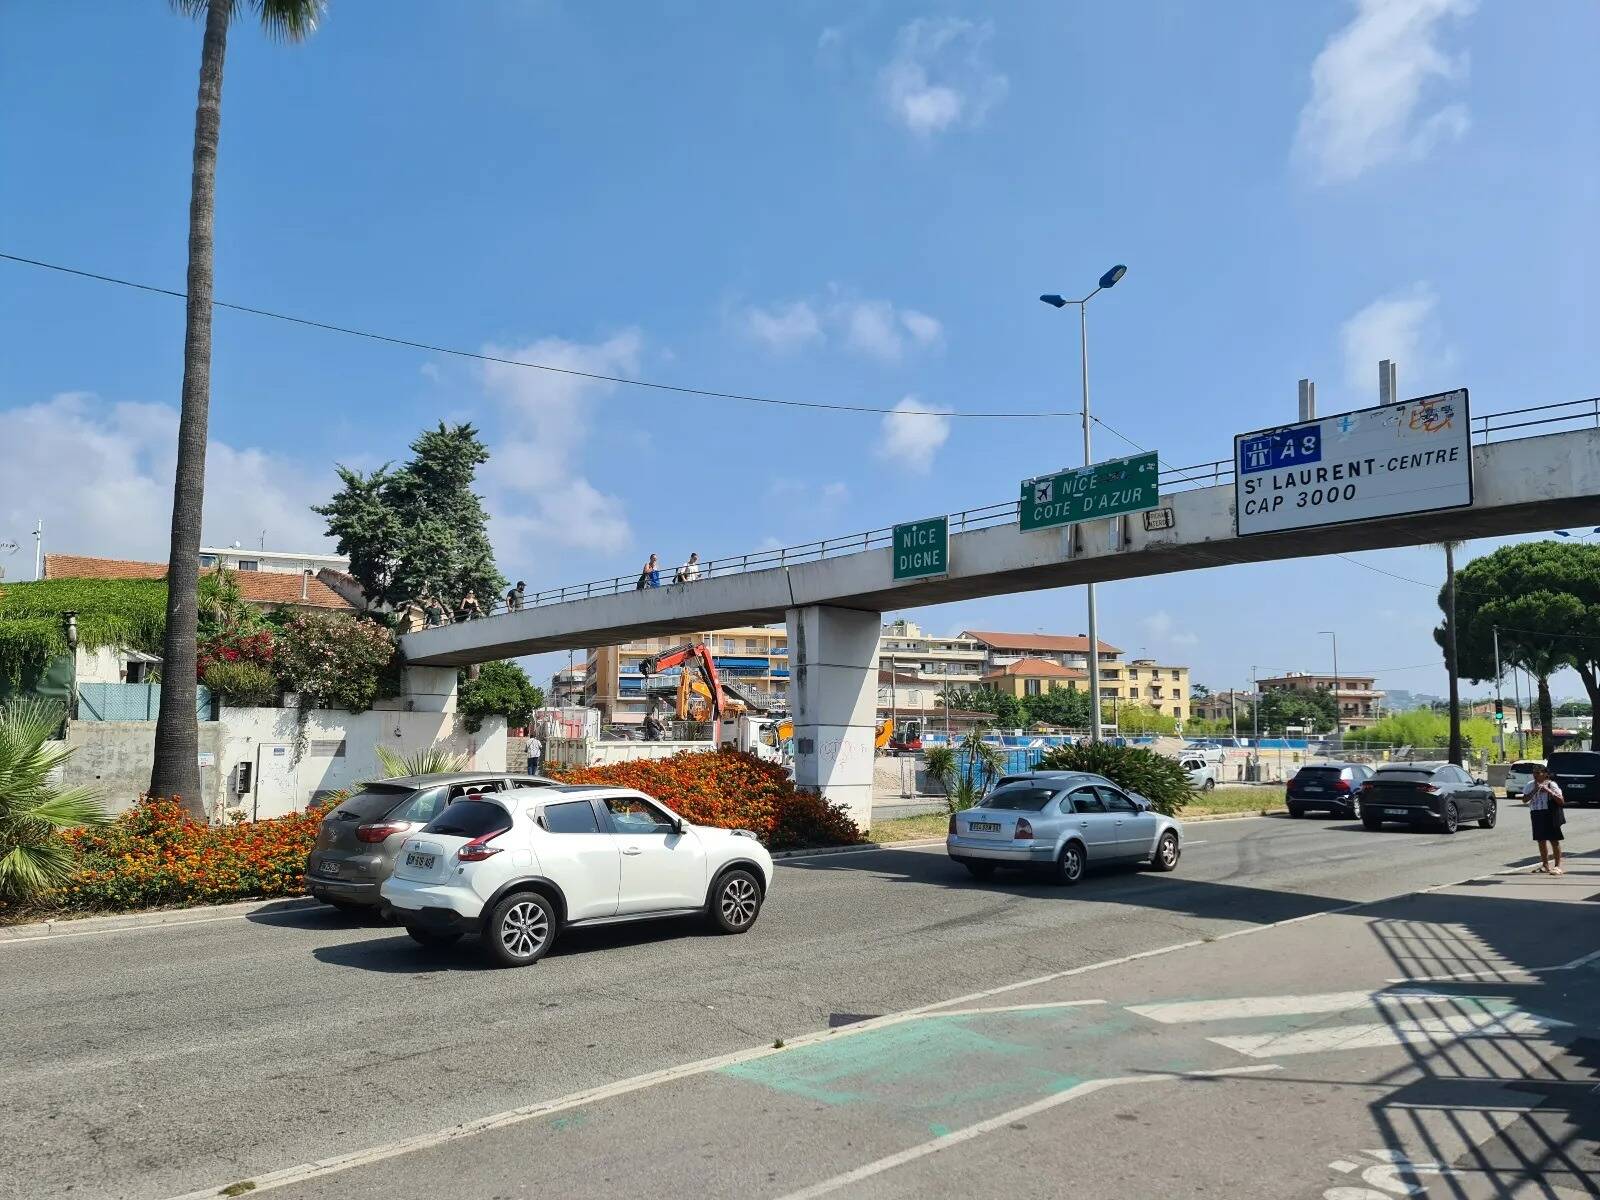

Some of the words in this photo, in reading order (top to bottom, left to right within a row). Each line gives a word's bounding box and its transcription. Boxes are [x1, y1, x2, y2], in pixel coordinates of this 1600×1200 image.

[1280, 435, 1316, 460] A8
[1062, 474, 1099, 495] NICE
[1034, 501, 1071, 521] COTE
[1083, 487, 1142, 512] D'AZUR
[1245, 495, 1284, 515] CAP
[1296, 484, 1356, 508] 3000
[903, 528, 936, 548] NICE
[900, 549, 940, 570] DIGNE
